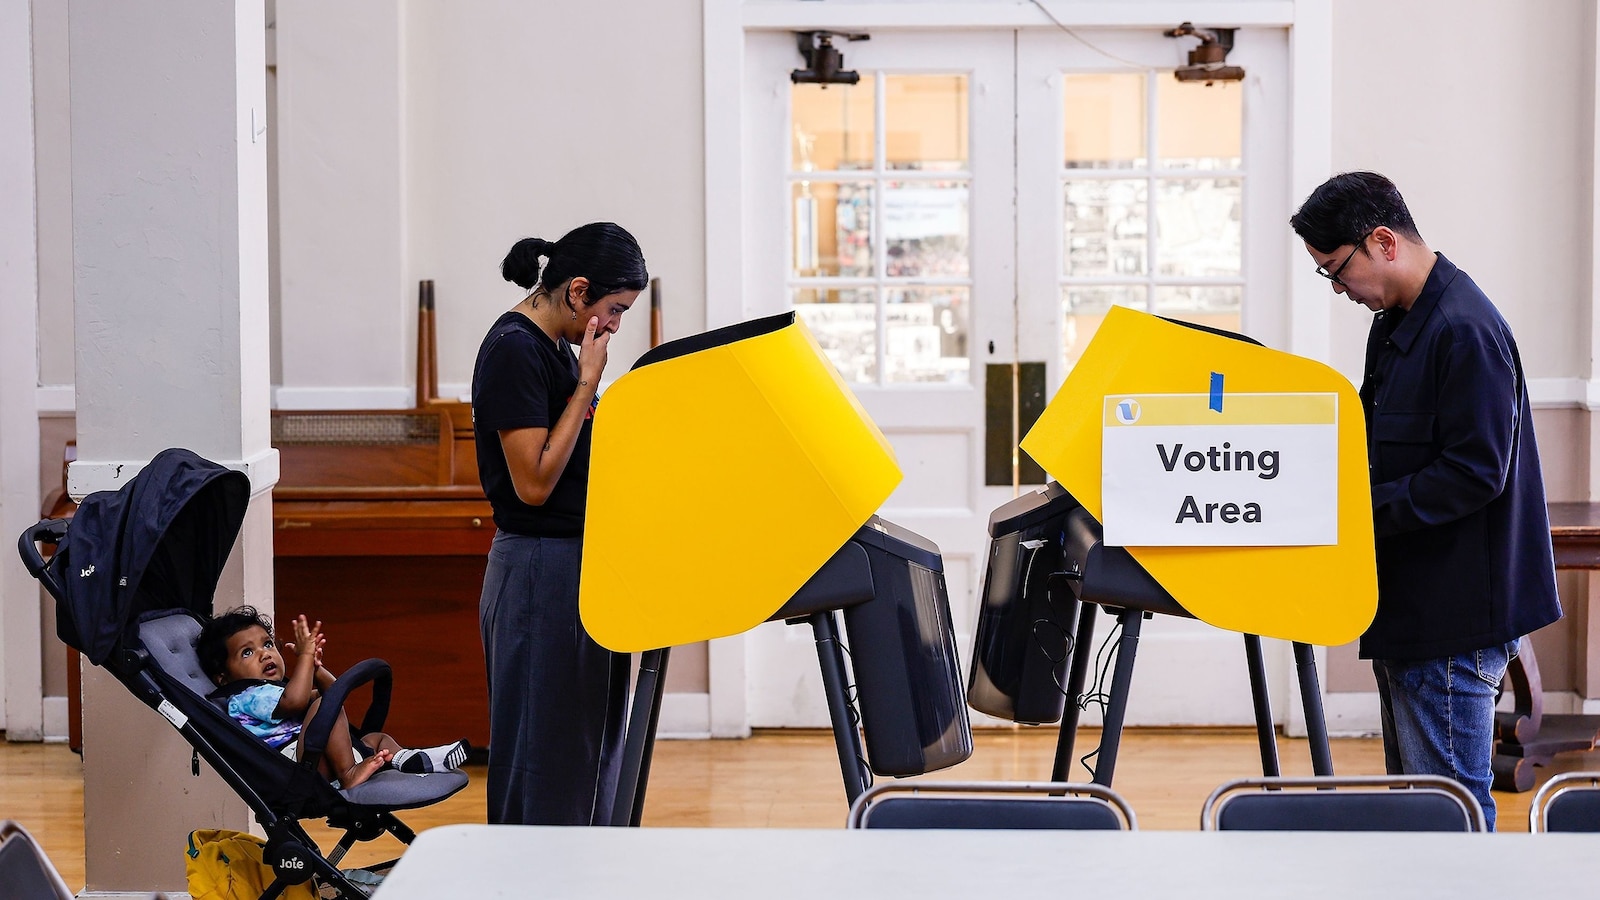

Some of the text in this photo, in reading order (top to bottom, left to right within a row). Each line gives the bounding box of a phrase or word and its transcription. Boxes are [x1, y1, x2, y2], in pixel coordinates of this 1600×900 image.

[1155, 442, 1280, 480] Voting
[1175, 495, 1262, 524] Area
[279, 856, 304, 870] Joie
